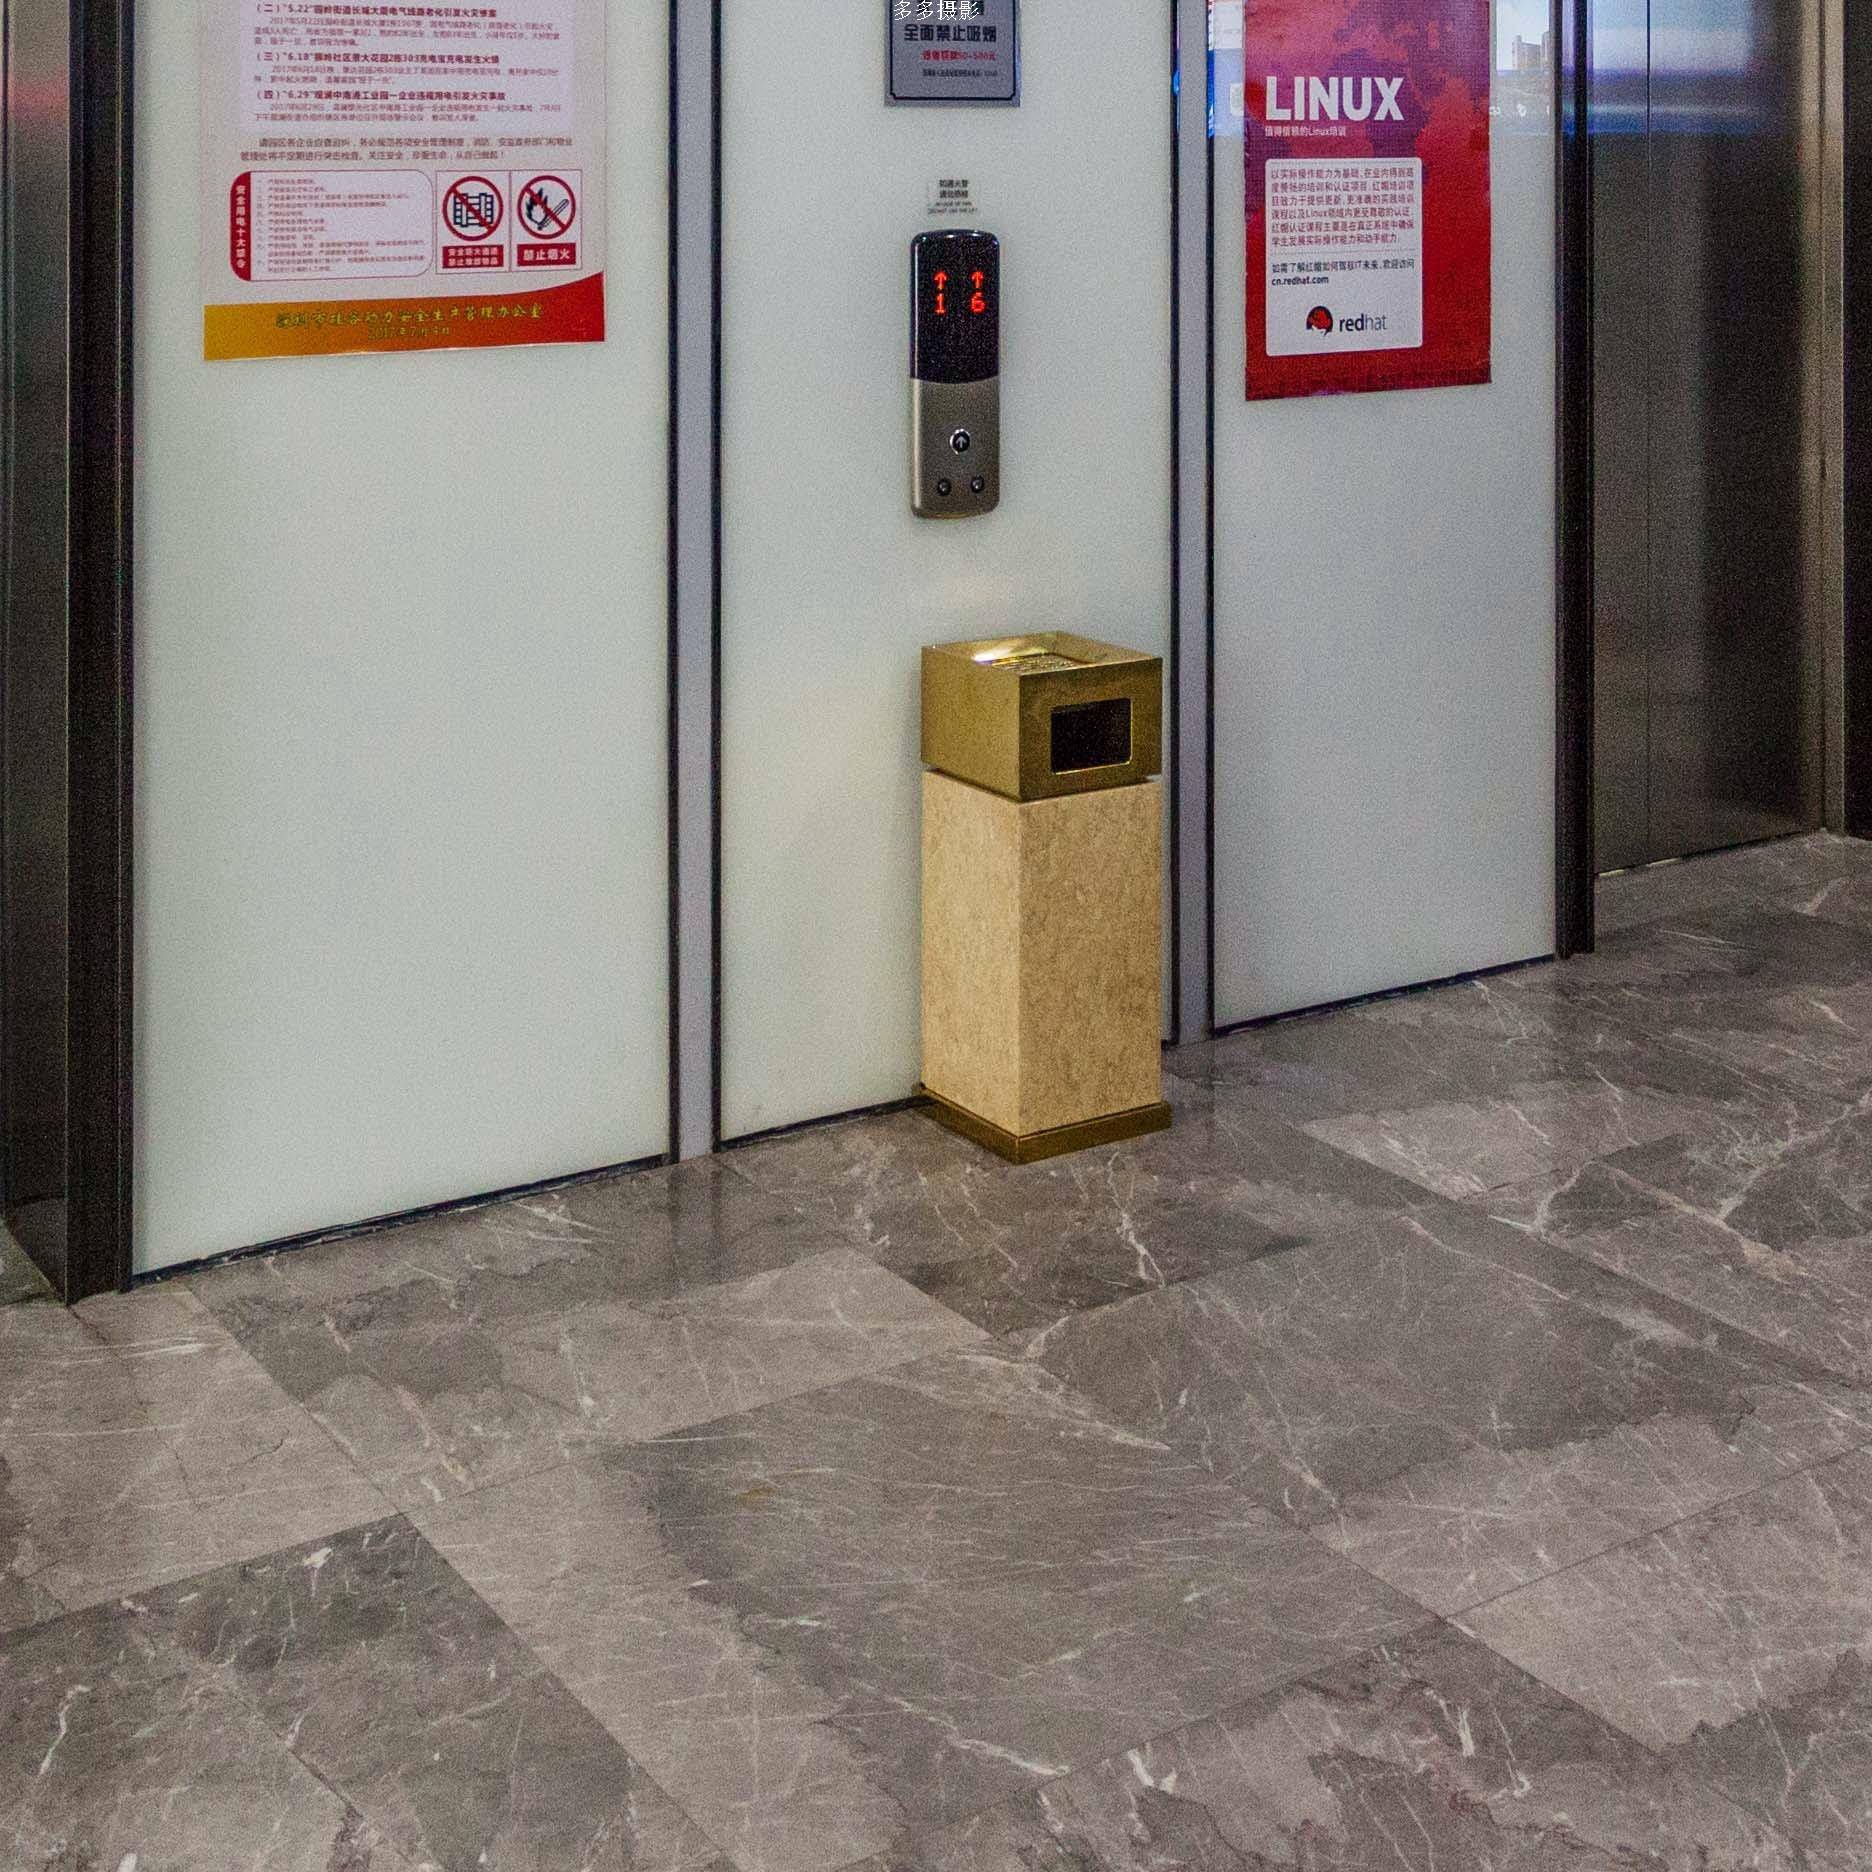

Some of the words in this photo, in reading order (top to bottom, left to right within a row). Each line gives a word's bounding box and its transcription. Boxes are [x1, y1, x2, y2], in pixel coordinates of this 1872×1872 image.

[904, 23, 997, 43] 全面禁止吸烟
[1265, 76, 1405, 121] LINUX
[1271, 275, 1330, 286] cn.redhat.com
[1339, 312, 1387, 333] redhat
